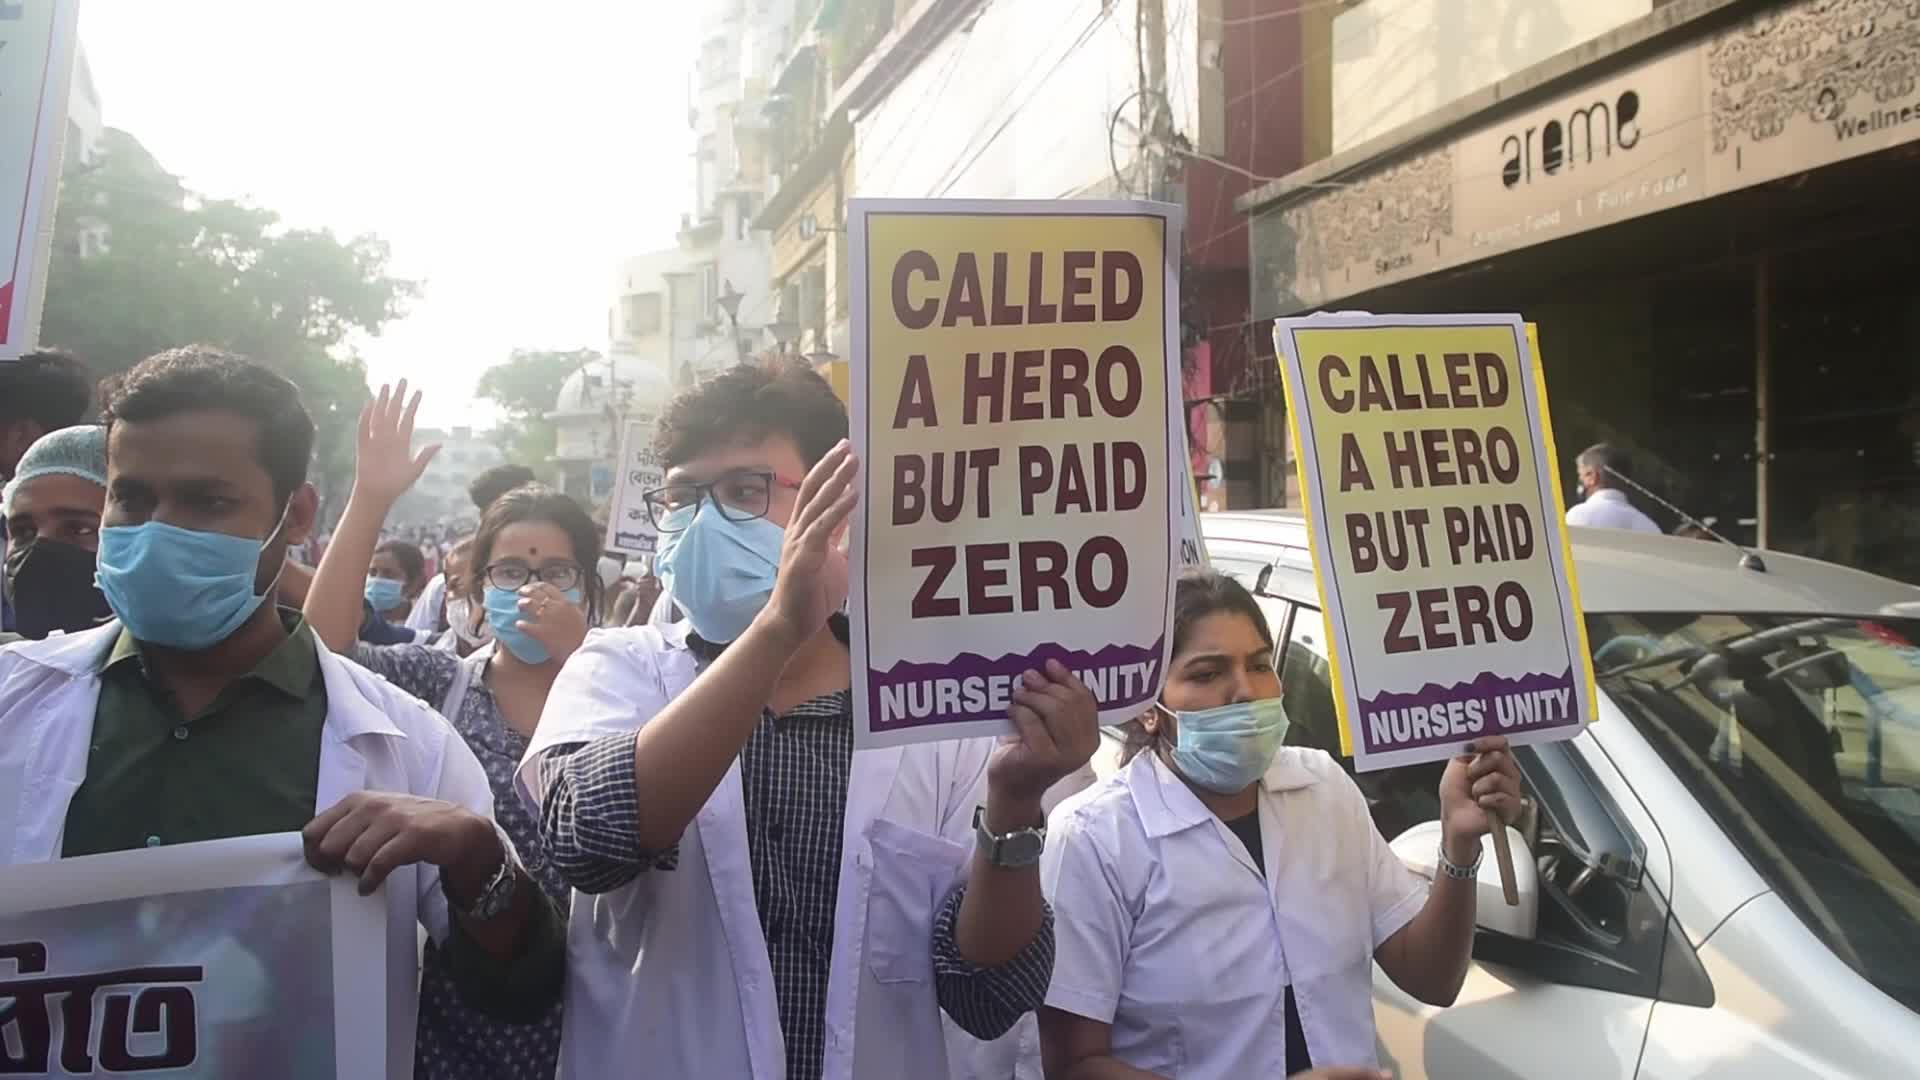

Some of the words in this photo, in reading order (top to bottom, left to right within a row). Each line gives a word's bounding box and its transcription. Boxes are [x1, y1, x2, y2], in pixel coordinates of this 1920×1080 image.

[891, 250, 1143, 330] CALLED
[892, 354, 939, 430] A
[962, 344, 1142, 425] HERO
[1318, 352, 1509, 414] CALLED
[892, 447, 1000, 526] BUT
[1018, 441, 1148, 516] PAID
[1340, 432, 1375, 493] A
[1383, 425, 1520, 489] HERO
[1345, 506, 1430, 574] BUT
[1443, 503, 1534, 566] PAID
[911, 535, 1129, 619] ZERO
[1376, 580, 1533, 654] ZERO
[879, 672, 1025, 722] NURSE
[1072, 658, 1158, 704] NITY
[1367, 698, 1488, 745] NURSES'
[1496, 687, 1571, 729] UNITY
